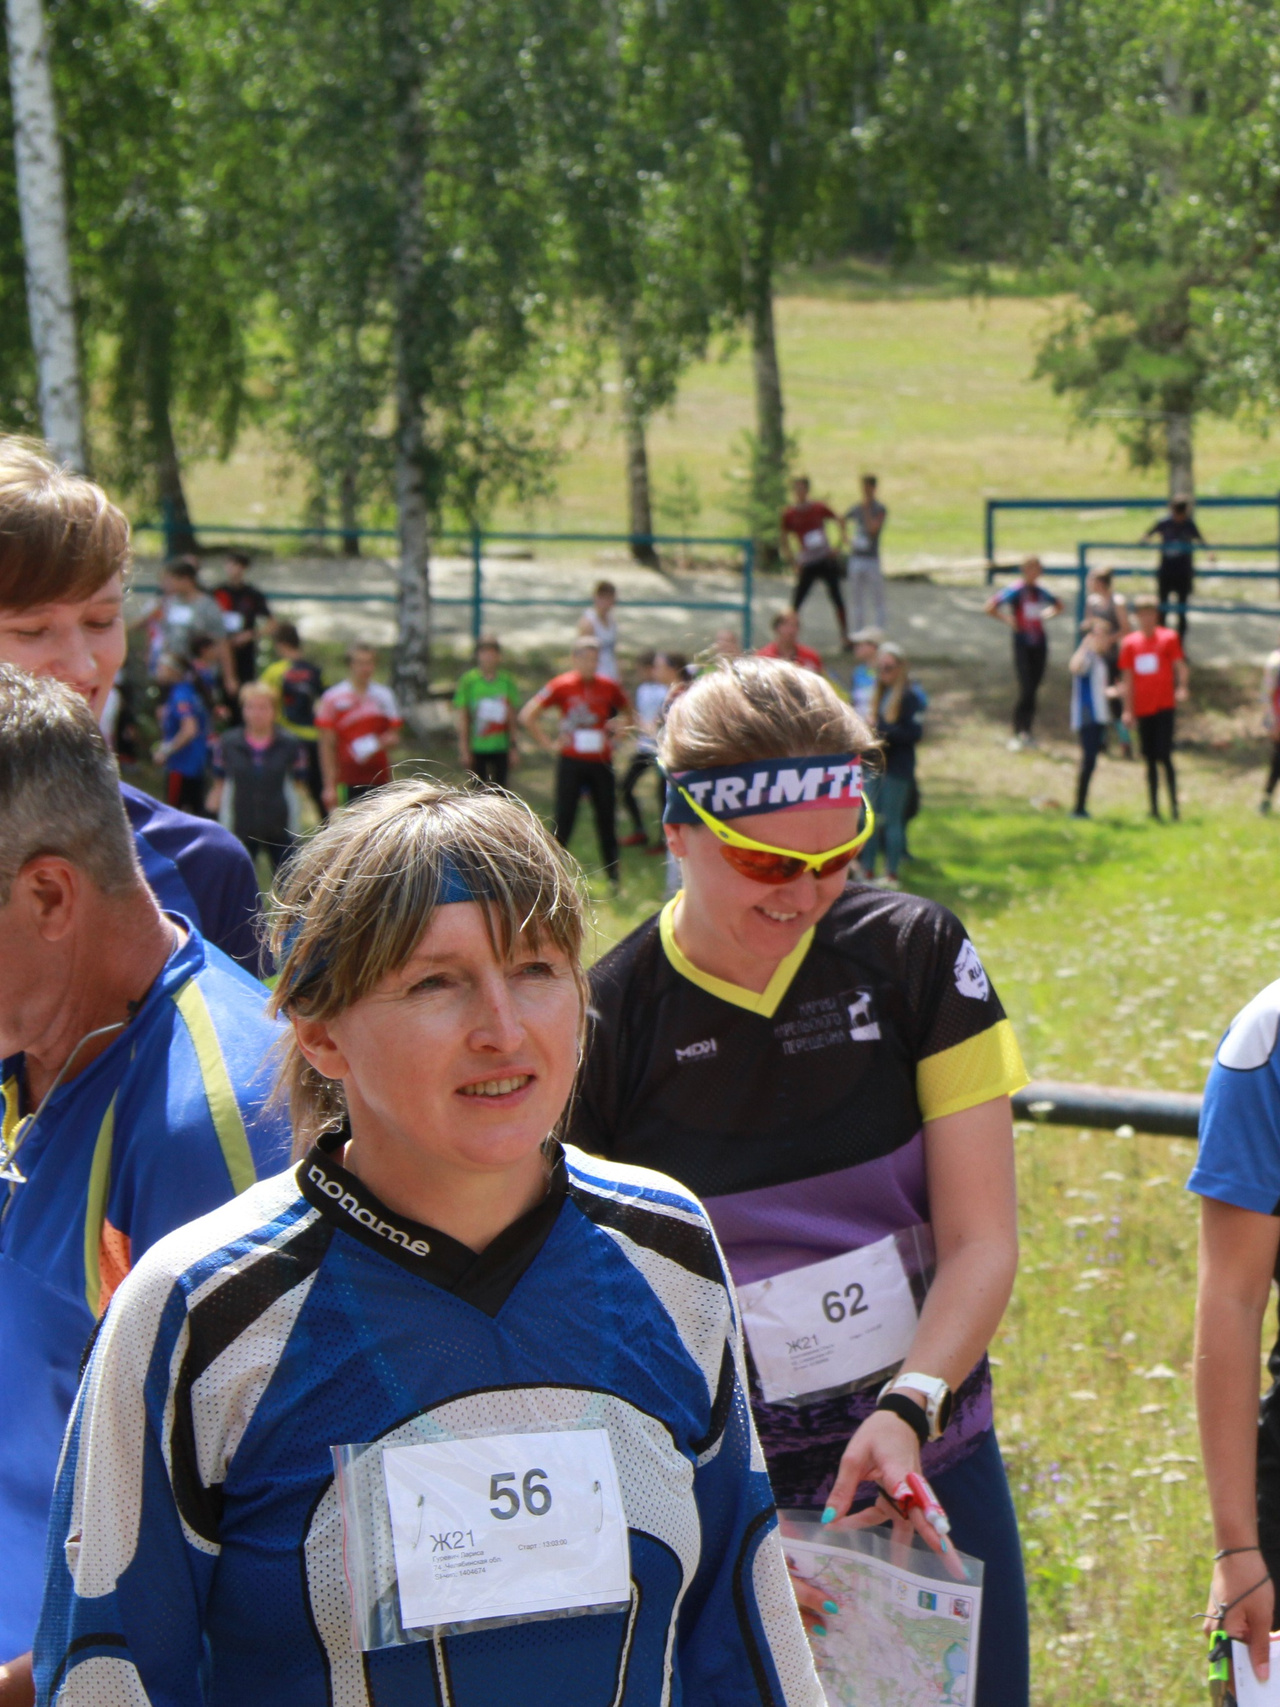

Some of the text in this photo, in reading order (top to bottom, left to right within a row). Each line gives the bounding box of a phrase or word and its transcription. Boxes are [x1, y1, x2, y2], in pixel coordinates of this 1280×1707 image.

[307, 1164, 431, 1257] noname
[822, 1282, 869, 1324] 62
[786, 1333, 820, 1355] Ж21
[489, 1467, 552, 1521] 56
[430, 1529, 475, 1553] Ж21
